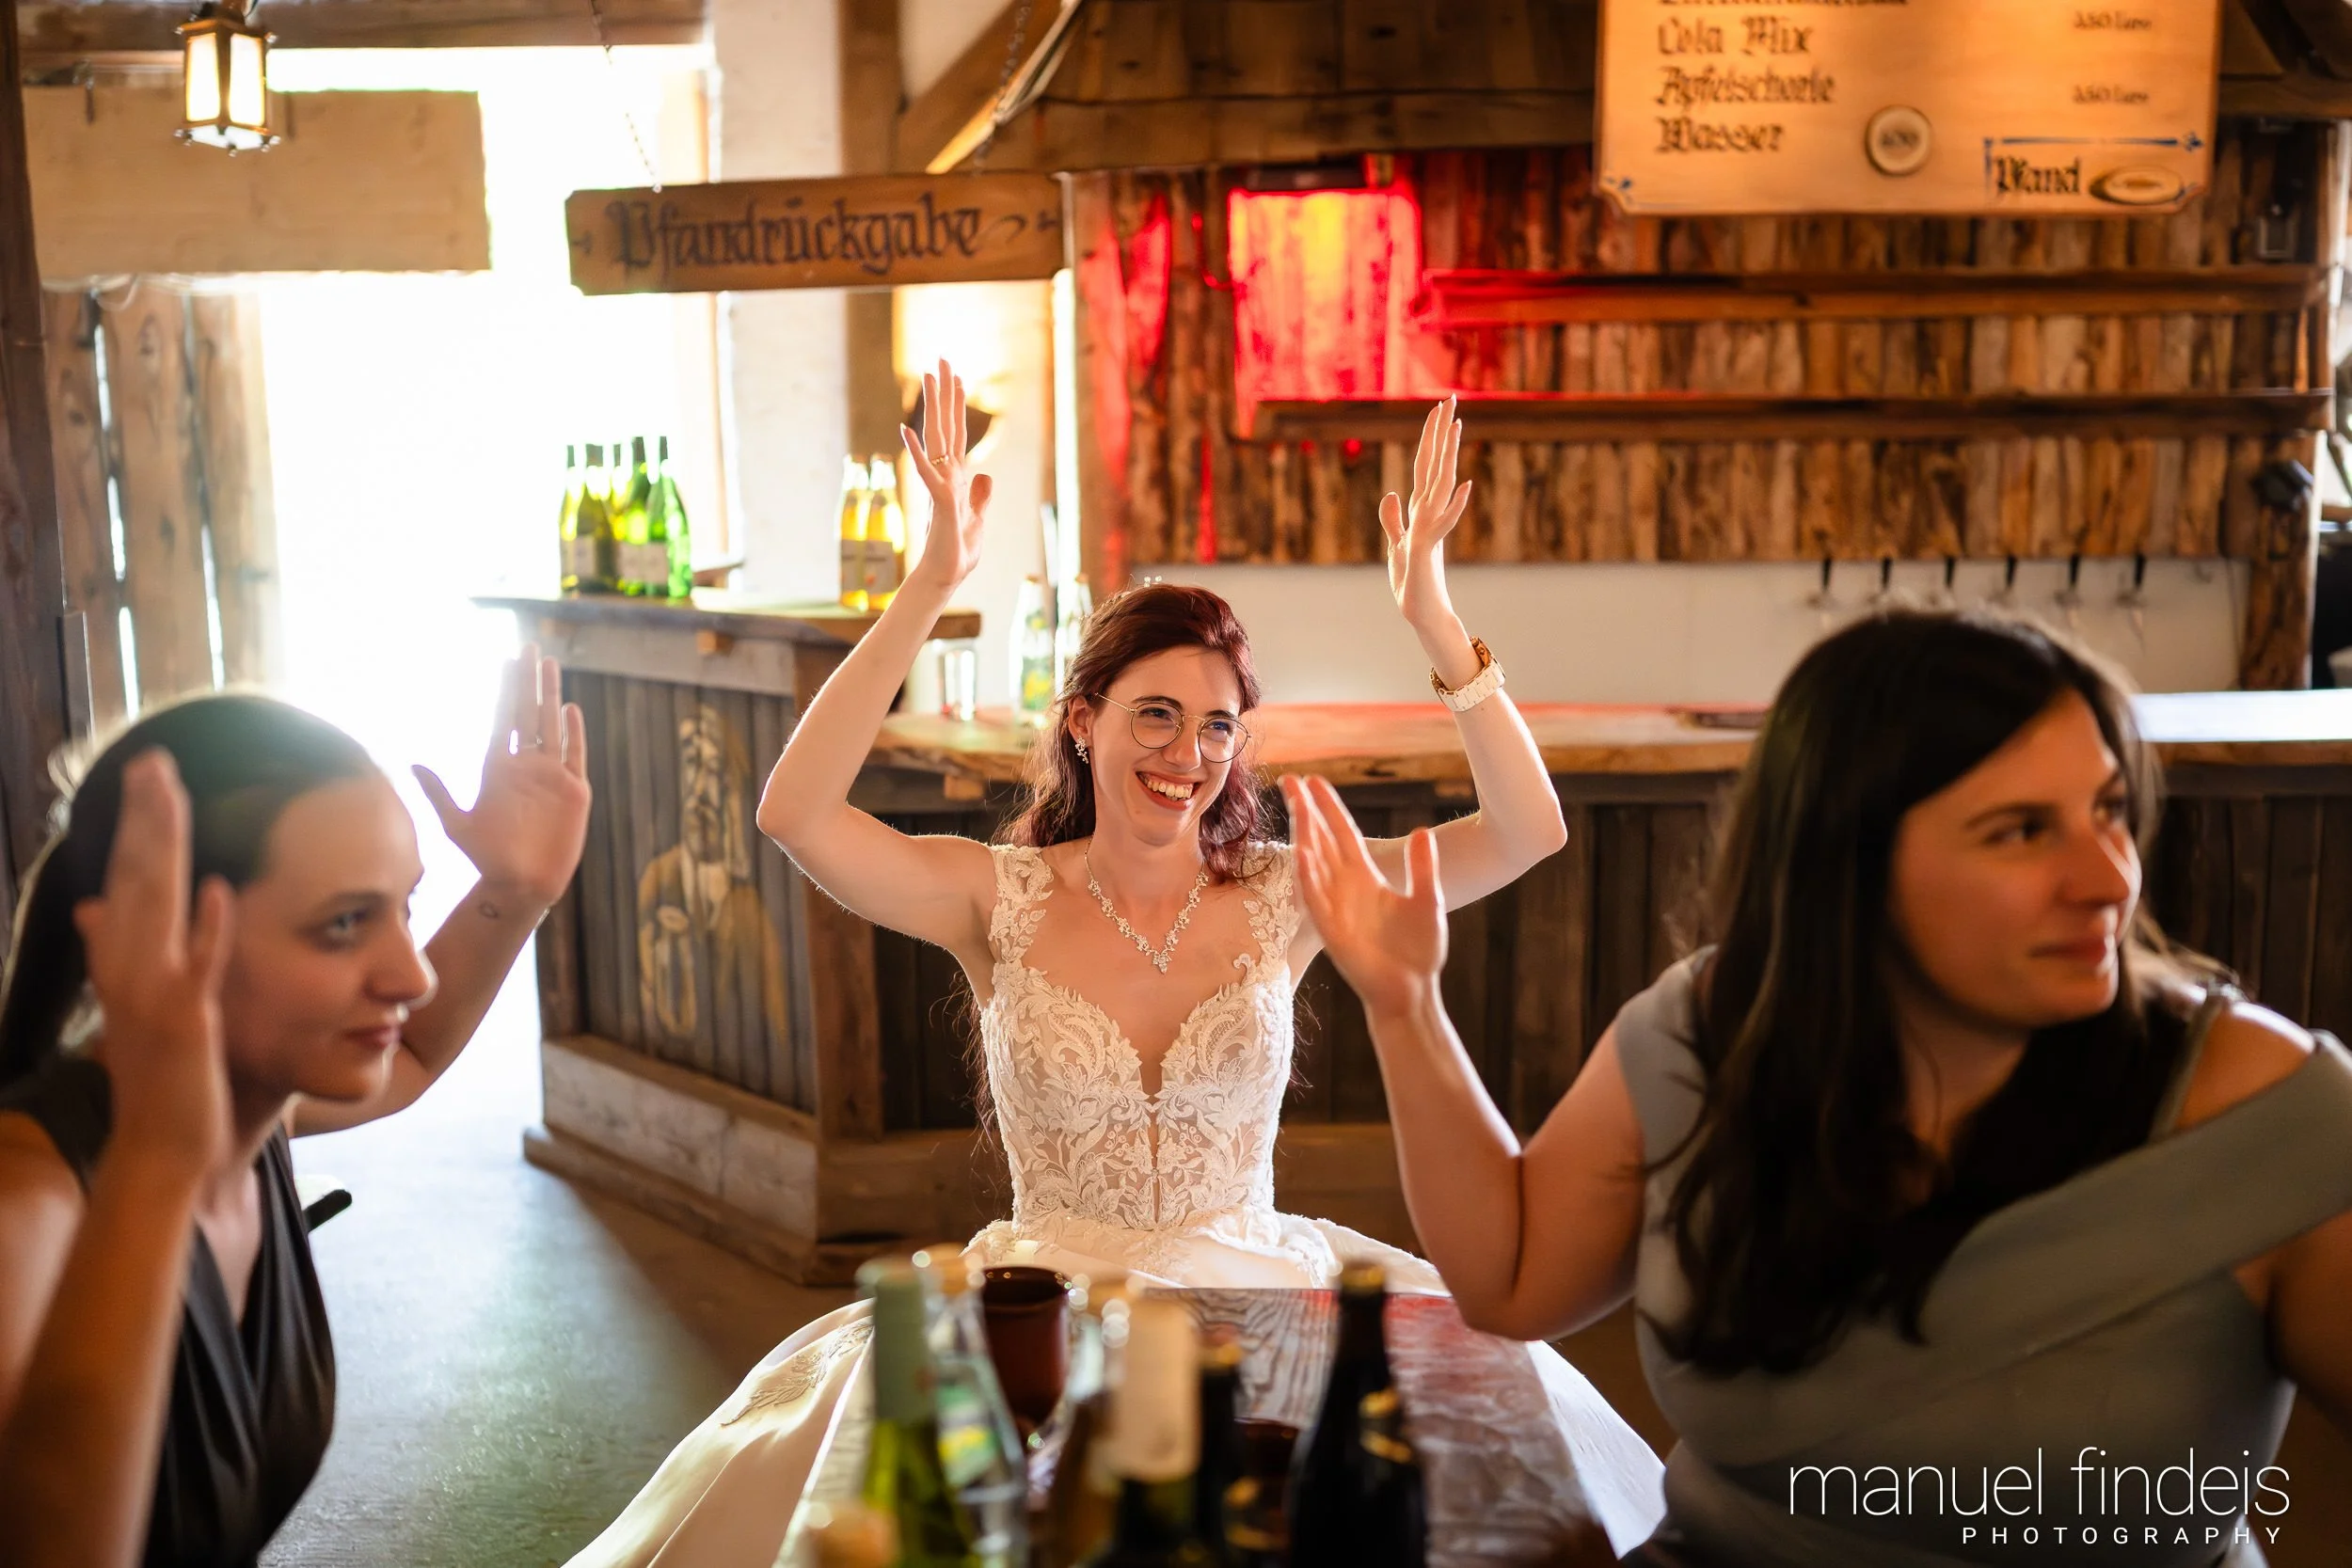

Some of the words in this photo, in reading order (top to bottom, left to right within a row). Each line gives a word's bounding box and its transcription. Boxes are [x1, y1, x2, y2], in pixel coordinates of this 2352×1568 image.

[1658, 17, 1724, 55] Cola
[1741, 15, 1813, 55] Mix
[1655, 115, 1785, 152] Wasser
[1995, 155, 2081, 196] Pfand
[605, 194, 980, 278] Pfandrückgabe
